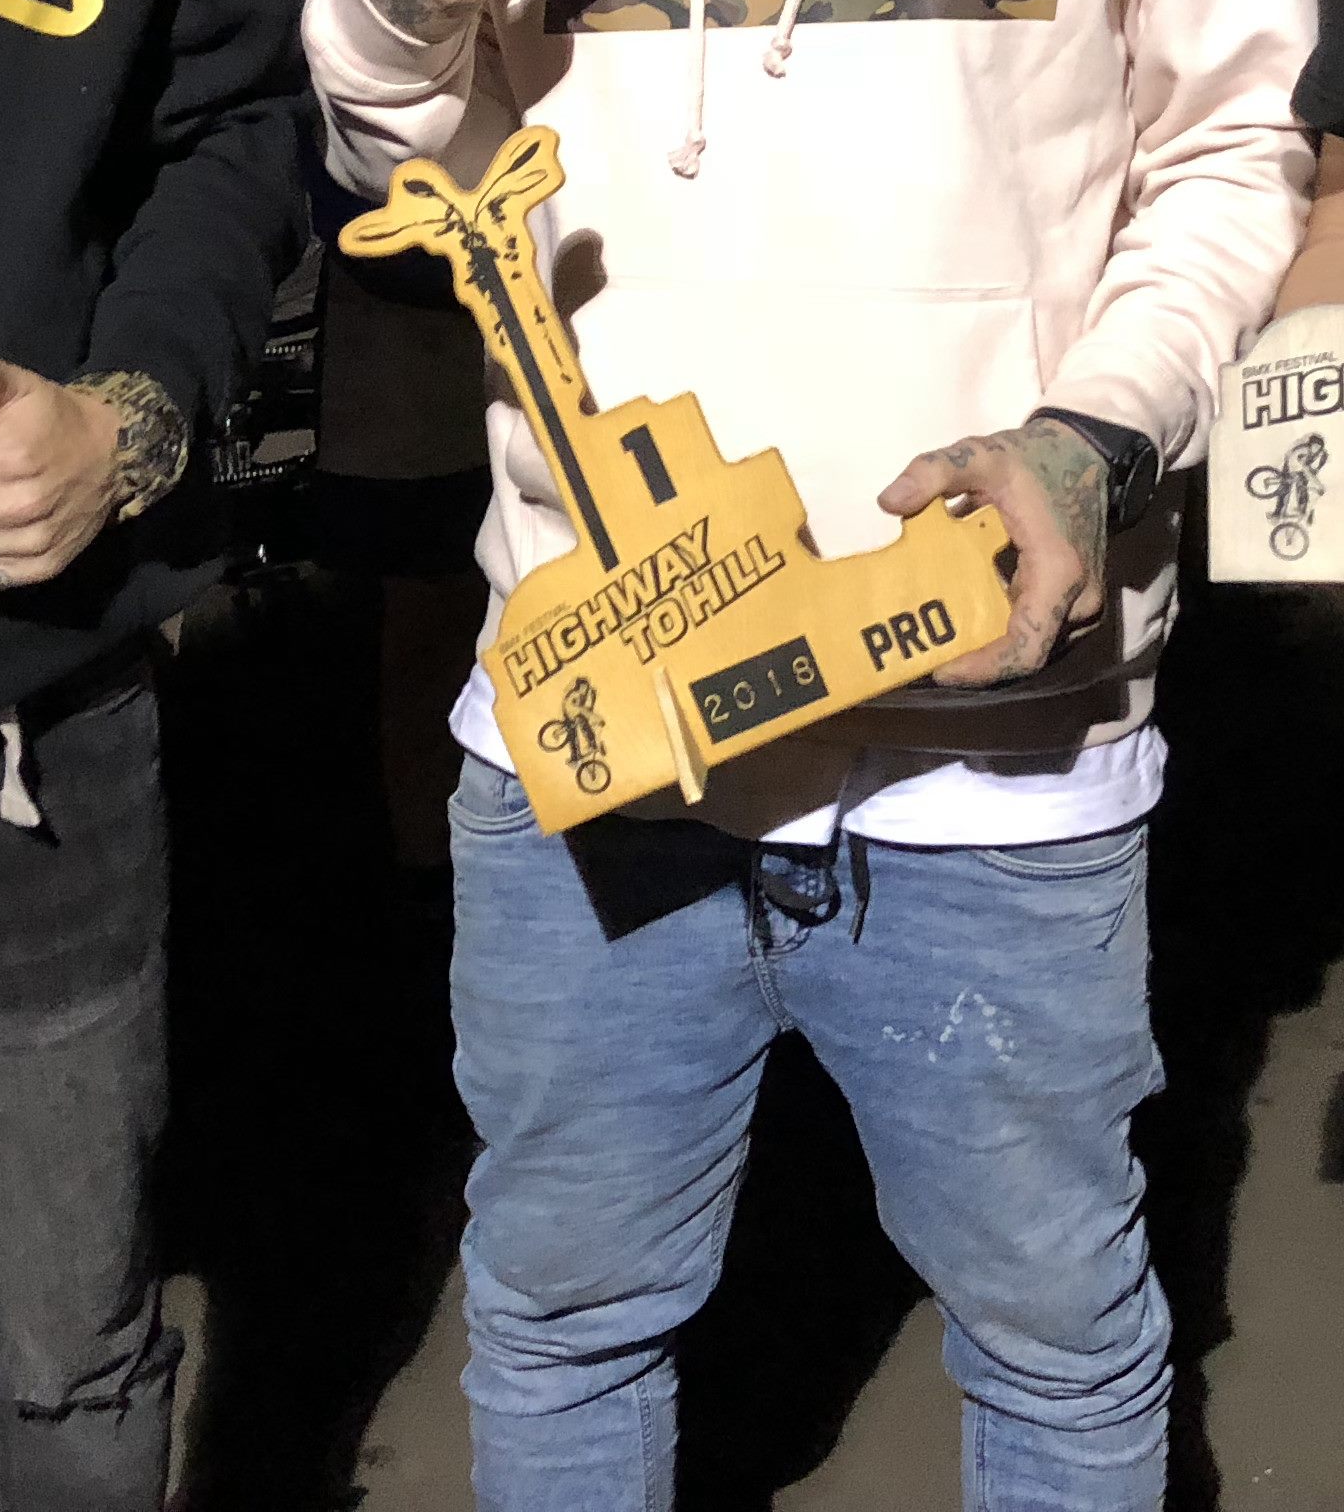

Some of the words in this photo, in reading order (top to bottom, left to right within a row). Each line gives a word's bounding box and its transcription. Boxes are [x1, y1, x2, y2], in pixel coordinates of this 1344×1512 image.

[620, 425, 677, 507] 1
[503, 515, 712, 699] HIGHWAY
[680, 534, 786, 628] HILL
[860, 599, 957, 672] PRO
[704, 655, 816, 725] 2018
